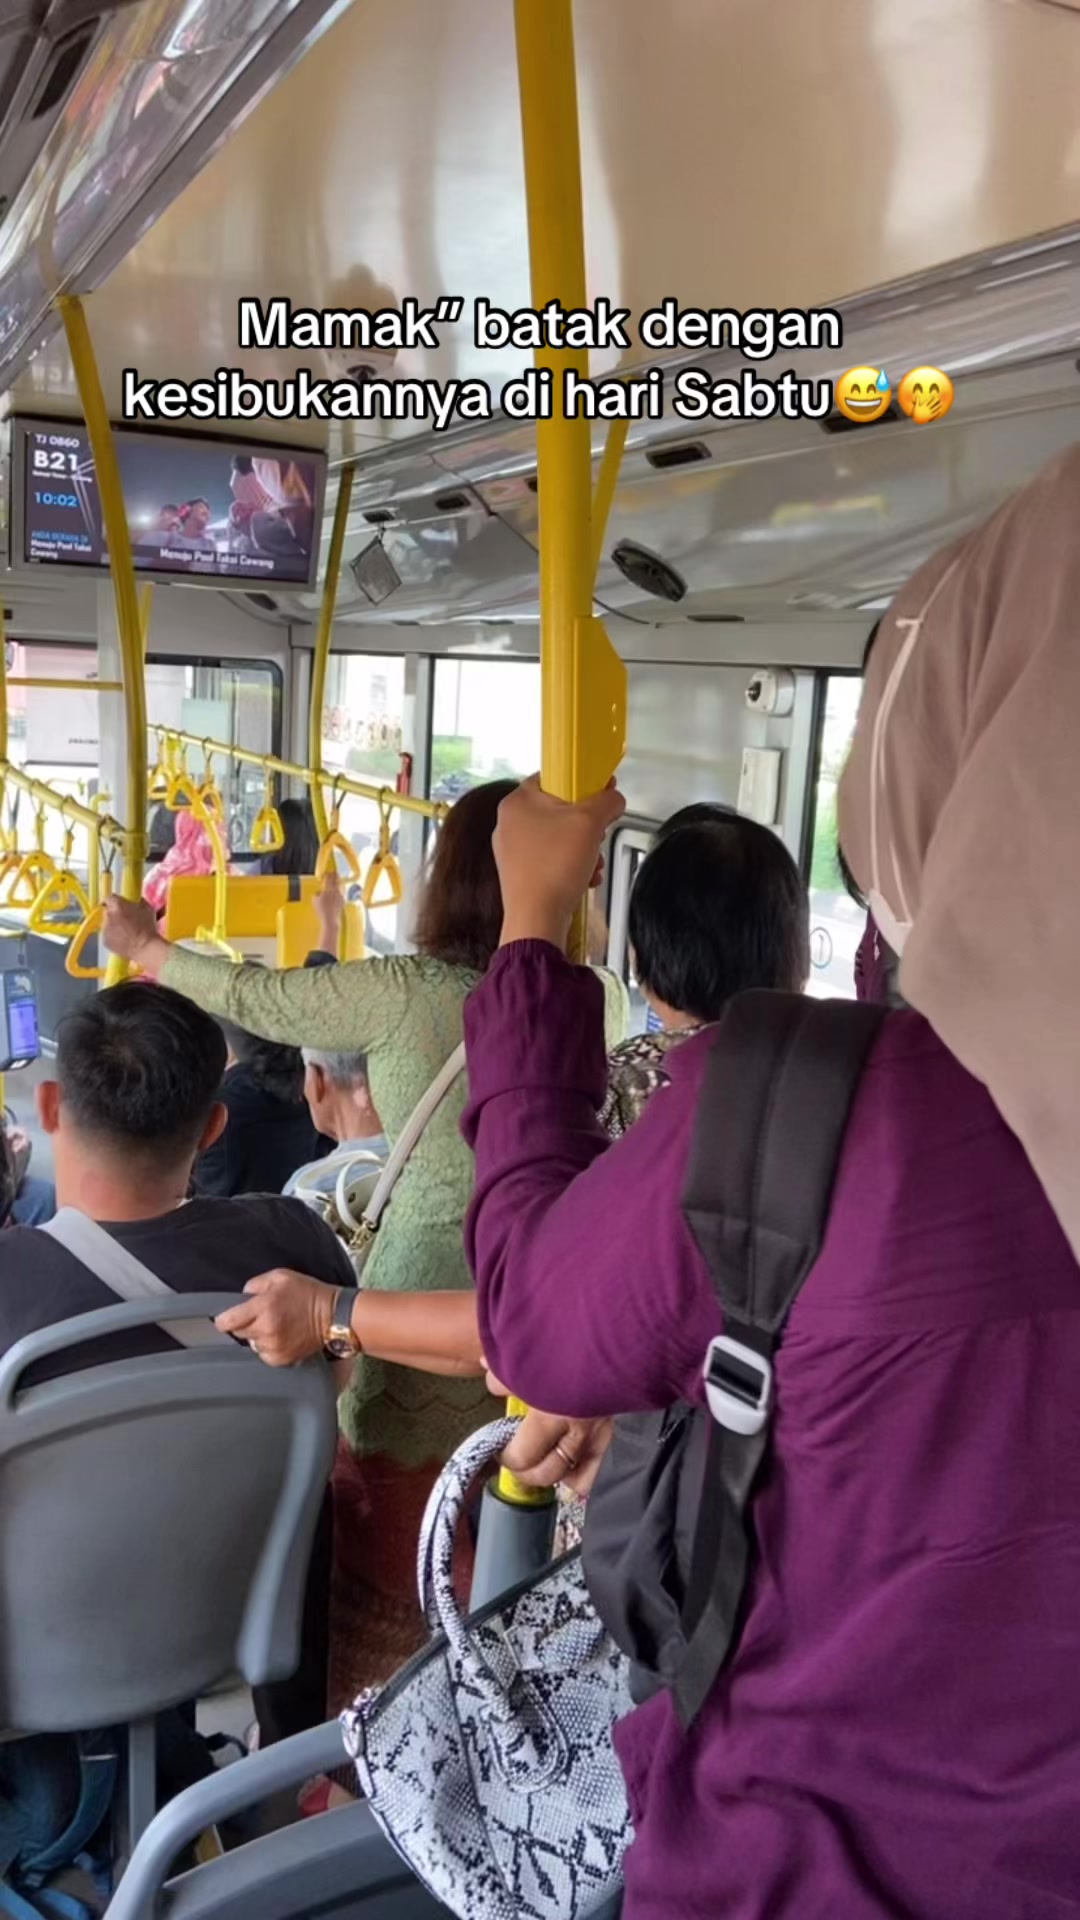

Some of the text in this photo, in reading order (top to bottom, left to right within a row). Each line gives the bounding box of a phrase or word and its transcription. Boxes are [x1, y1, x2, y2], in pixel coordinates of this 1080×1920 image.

[35, 434, 47, 444] TJ
[34, 450, 78, 471] B21
[34, 492, 77, 507] 10:02
[159, 548, 192, 561] Menuju
